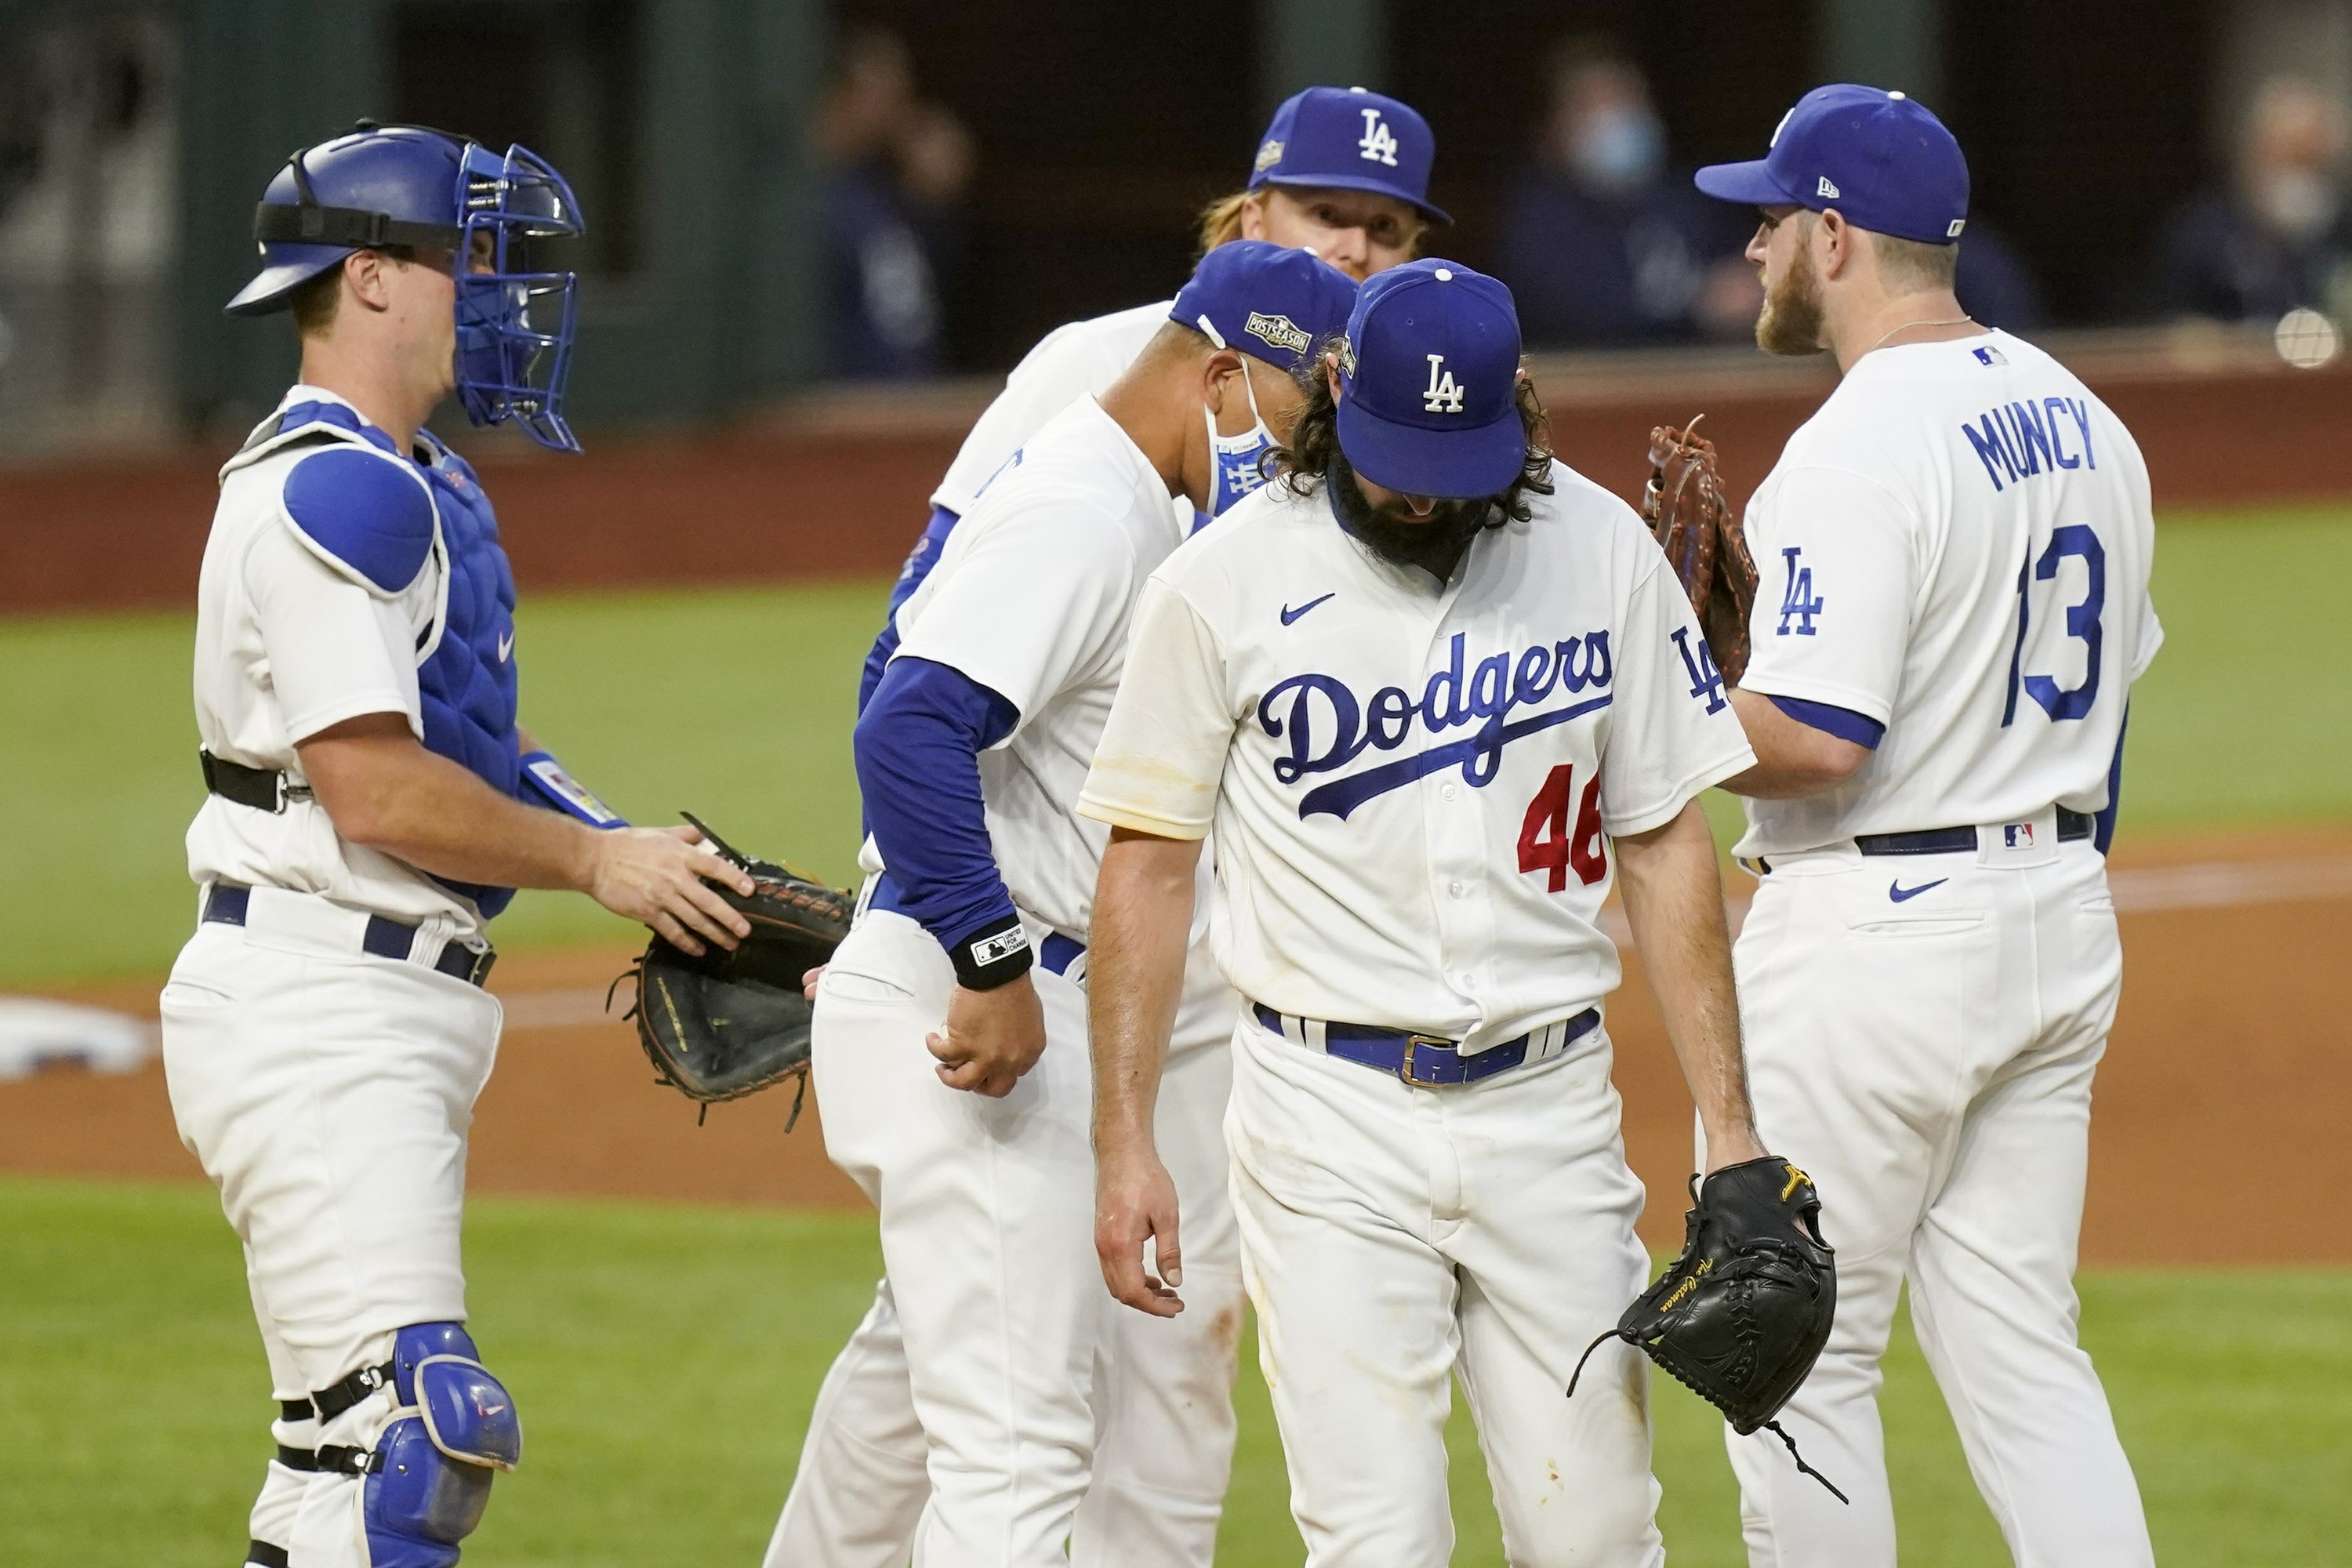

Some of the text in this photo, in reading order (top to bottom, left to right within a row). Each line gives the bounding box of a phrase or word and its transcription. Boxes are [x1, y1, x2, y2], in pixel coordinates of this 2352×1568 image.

[1359, 108, 1398, 166] LA
[1248, 317, 1308, 350] POSTSEASON
[1423, 354, 1464, 412] LA
[1962, 397, 2096, 492] MUNCY
[1777, 547, 1824, 635] LA
[2001, 524, 2105, 728] 13
[1258, 630, 1613, 789] Dodgers
[1671, 626, 1731, 716] LA
[1517, 764, 1607, 893] 46
